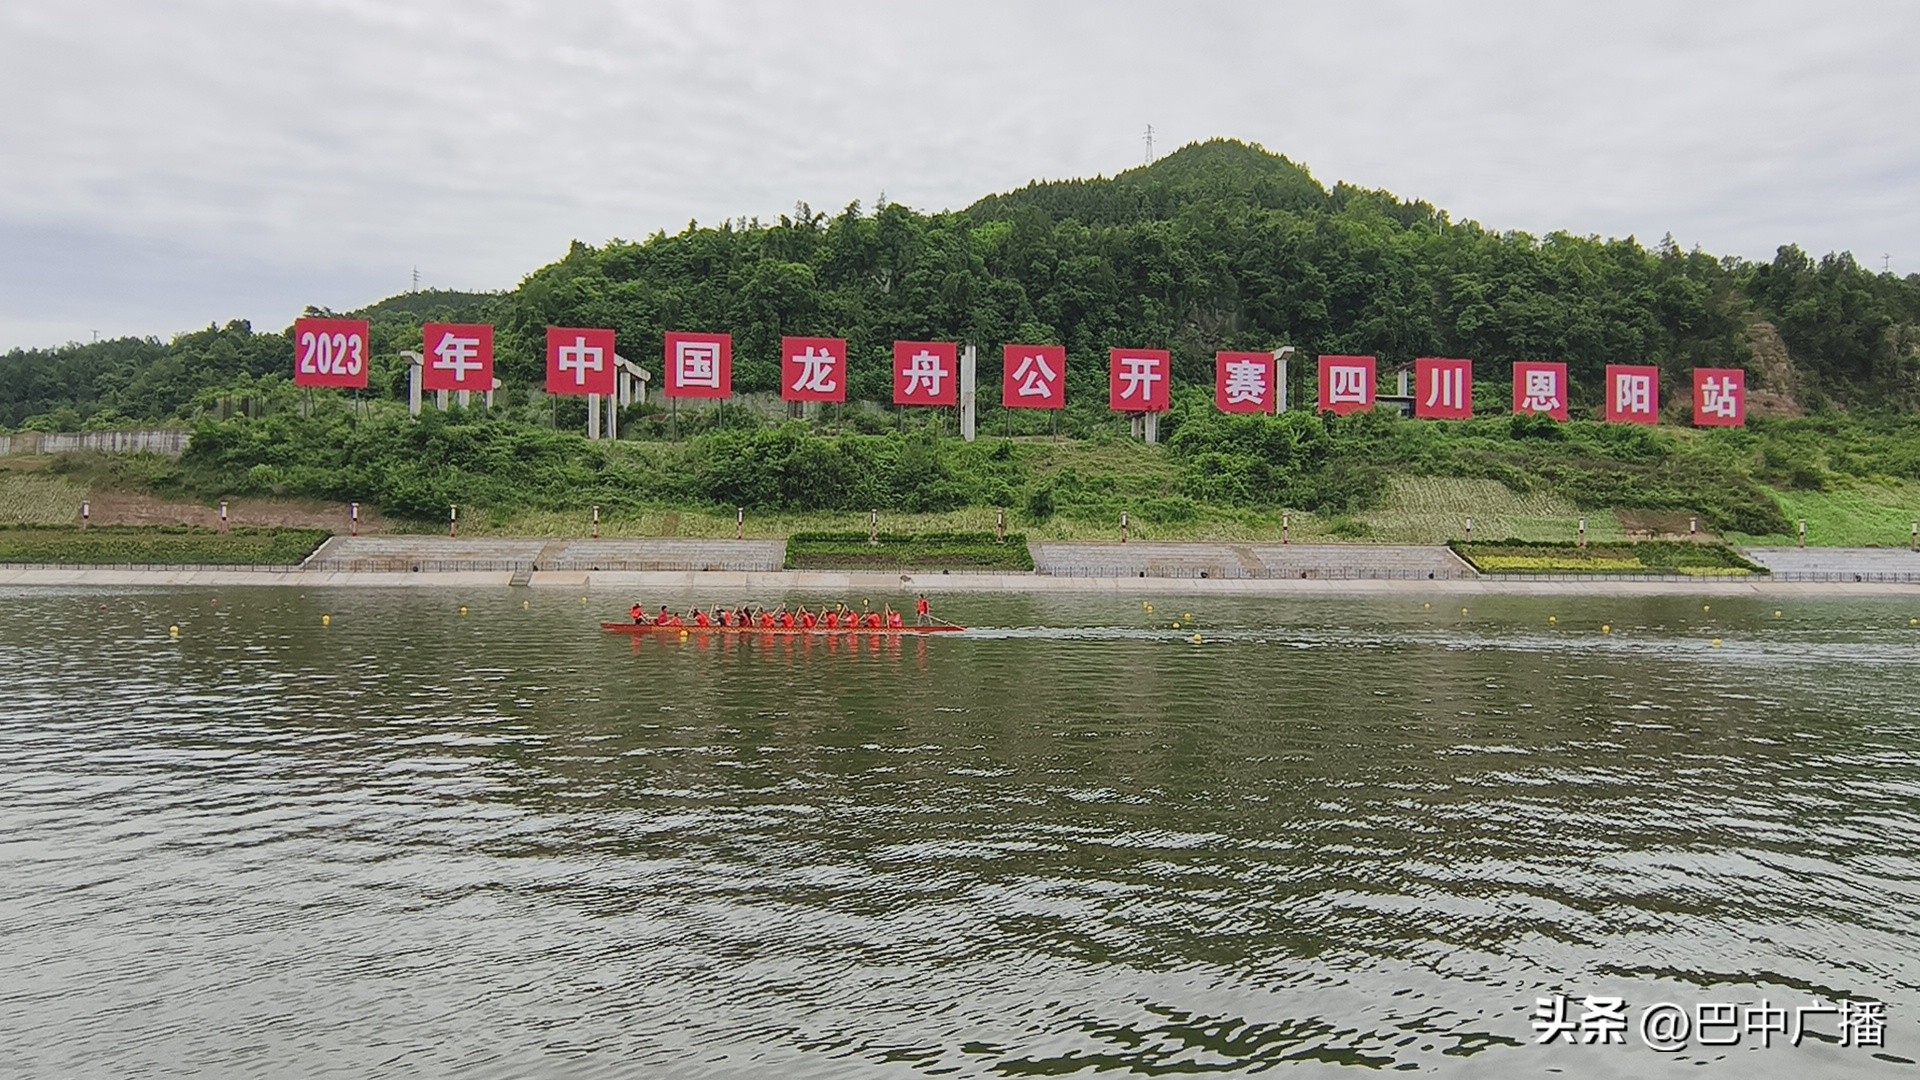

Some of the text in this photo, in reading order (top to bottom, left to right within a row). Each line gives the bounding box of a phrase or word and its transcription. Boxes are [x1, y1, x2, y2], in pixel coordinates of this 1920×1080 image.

[301, 332, 1737, 418] 2023 年 中 国 龙 舟 公 开 赛 四 川 恩 阳 站
